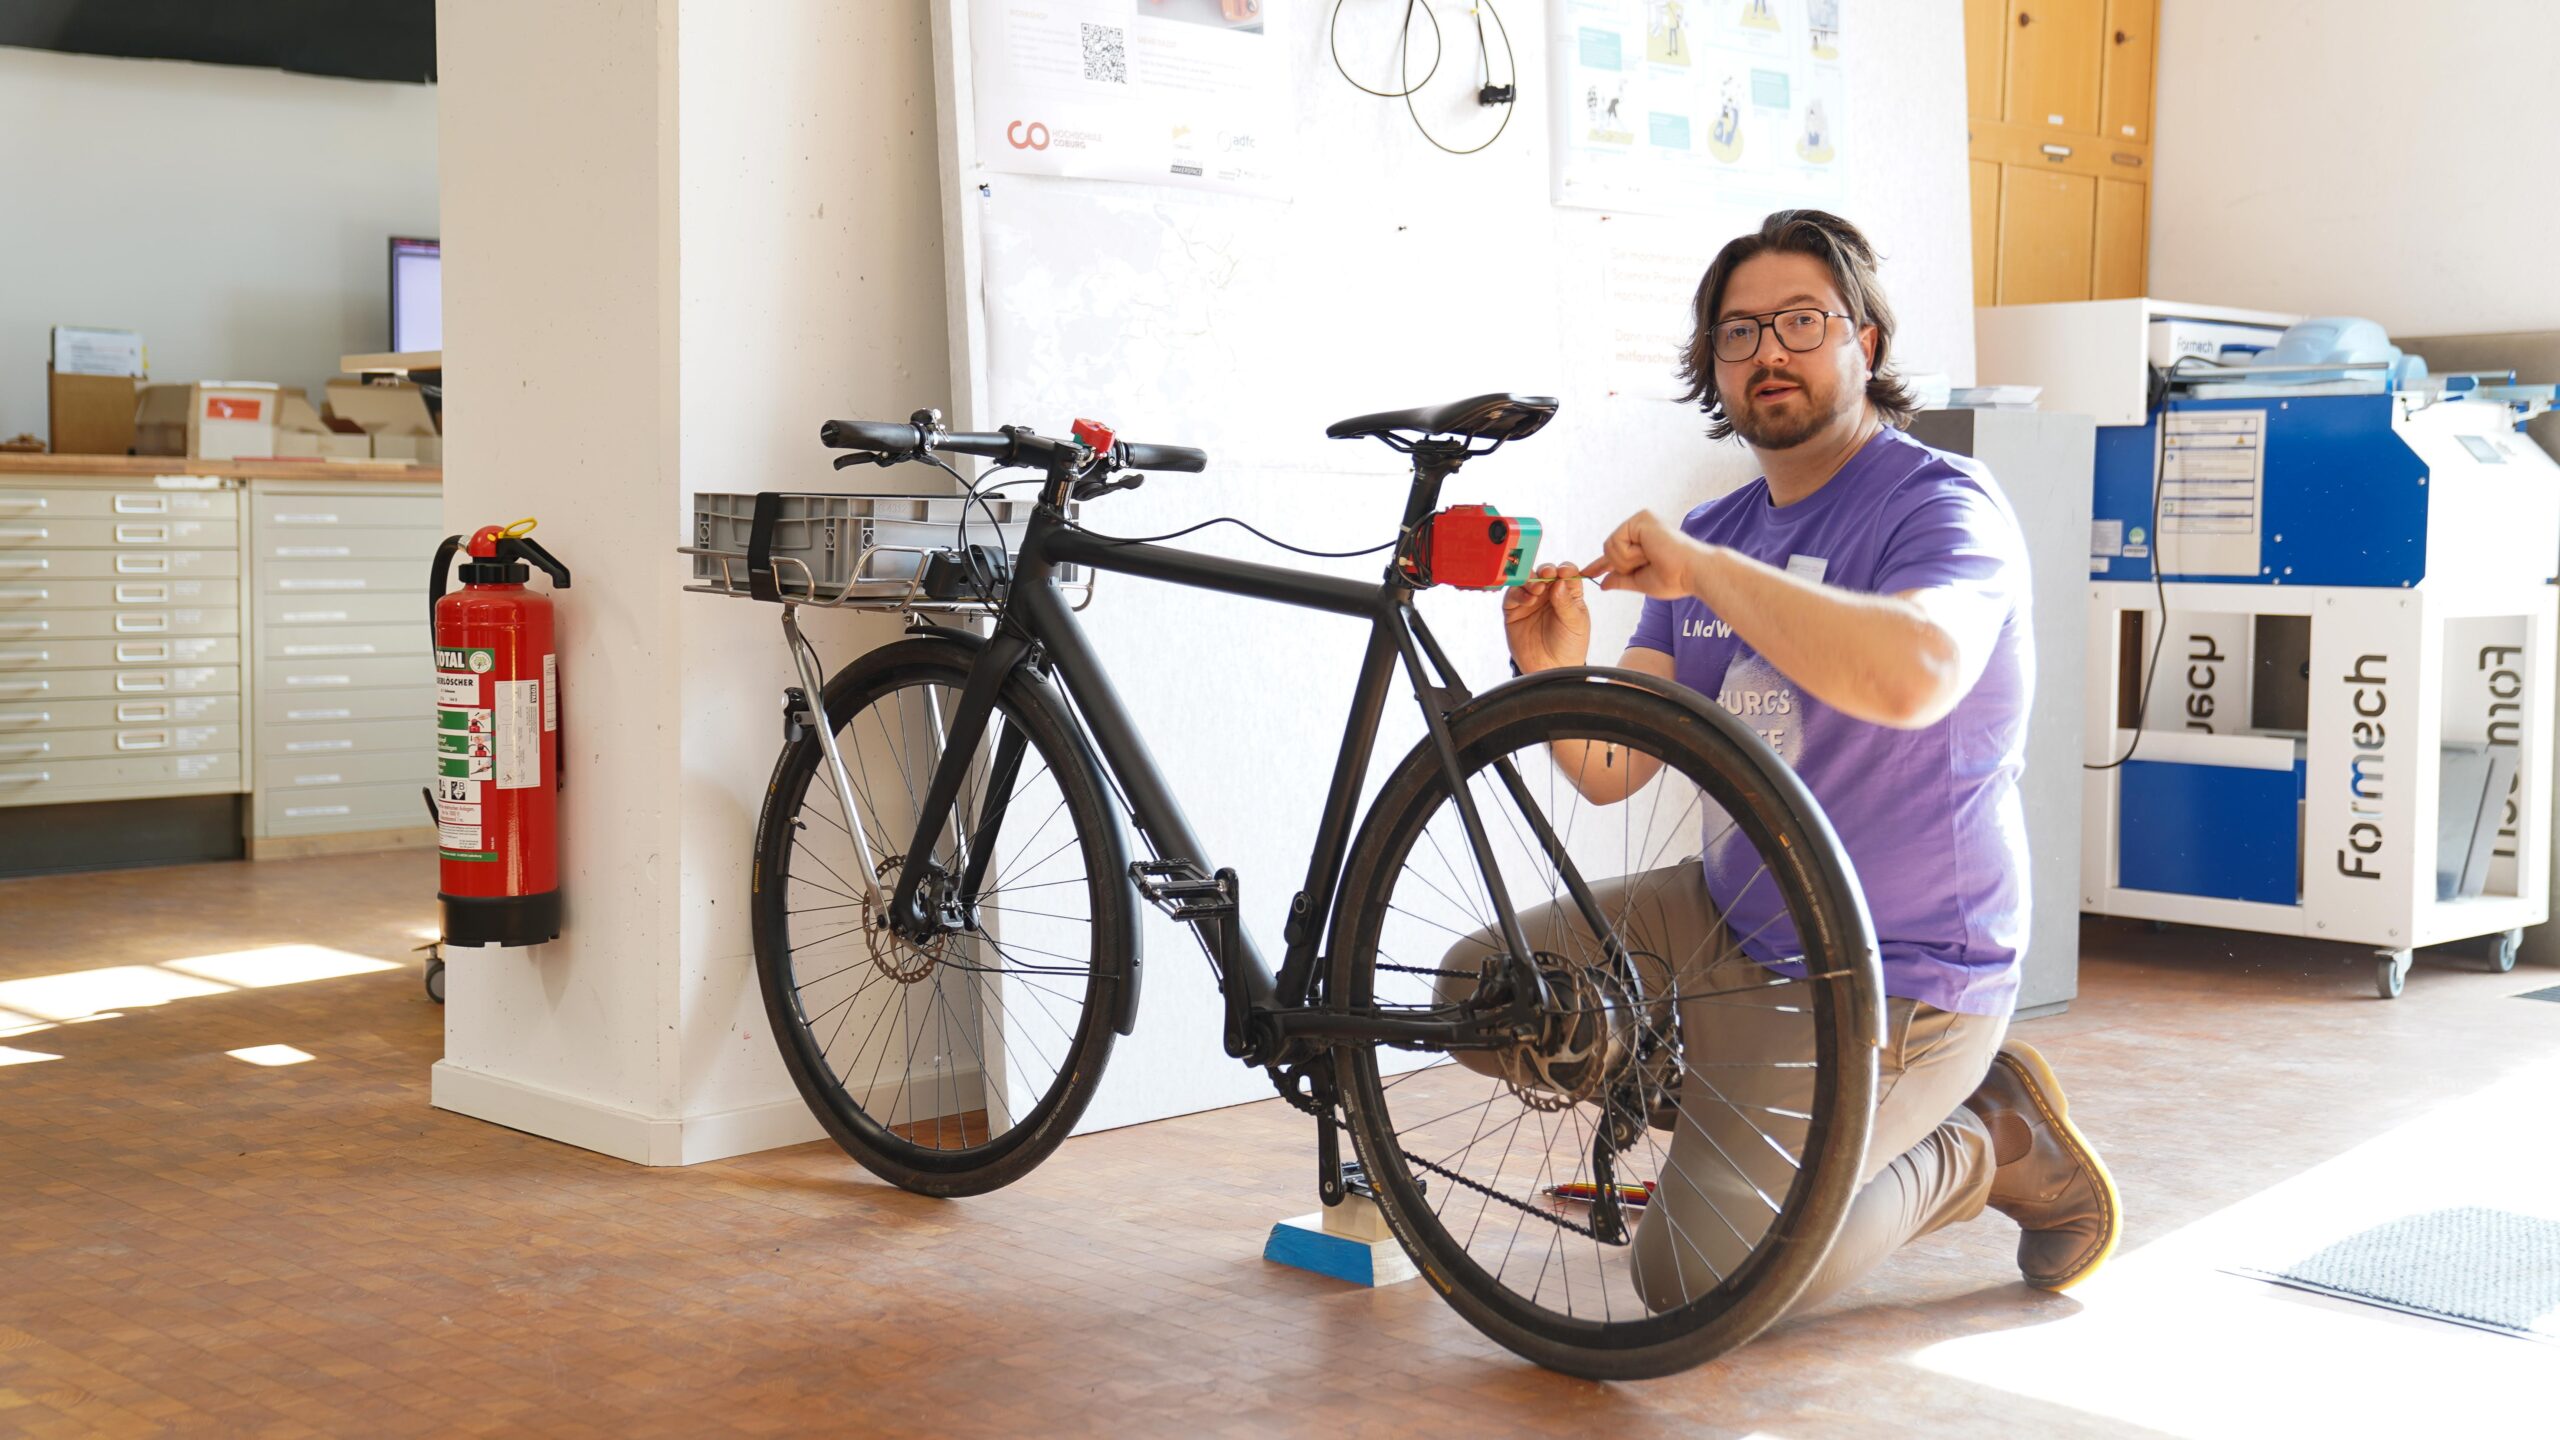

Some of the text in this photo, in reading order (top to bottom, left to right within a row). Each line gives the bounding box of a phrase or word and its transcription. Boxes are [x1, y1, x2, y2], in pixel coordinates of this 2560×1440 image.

[1053, 138, 1087, 150] COBURG
[1233, 135, 1256, 149] adfc
[2177, 334, 2214, 354] Formech
[1682, 619, 1733, 639] LNdW
[2337, 654, 2387, 880] Formech
